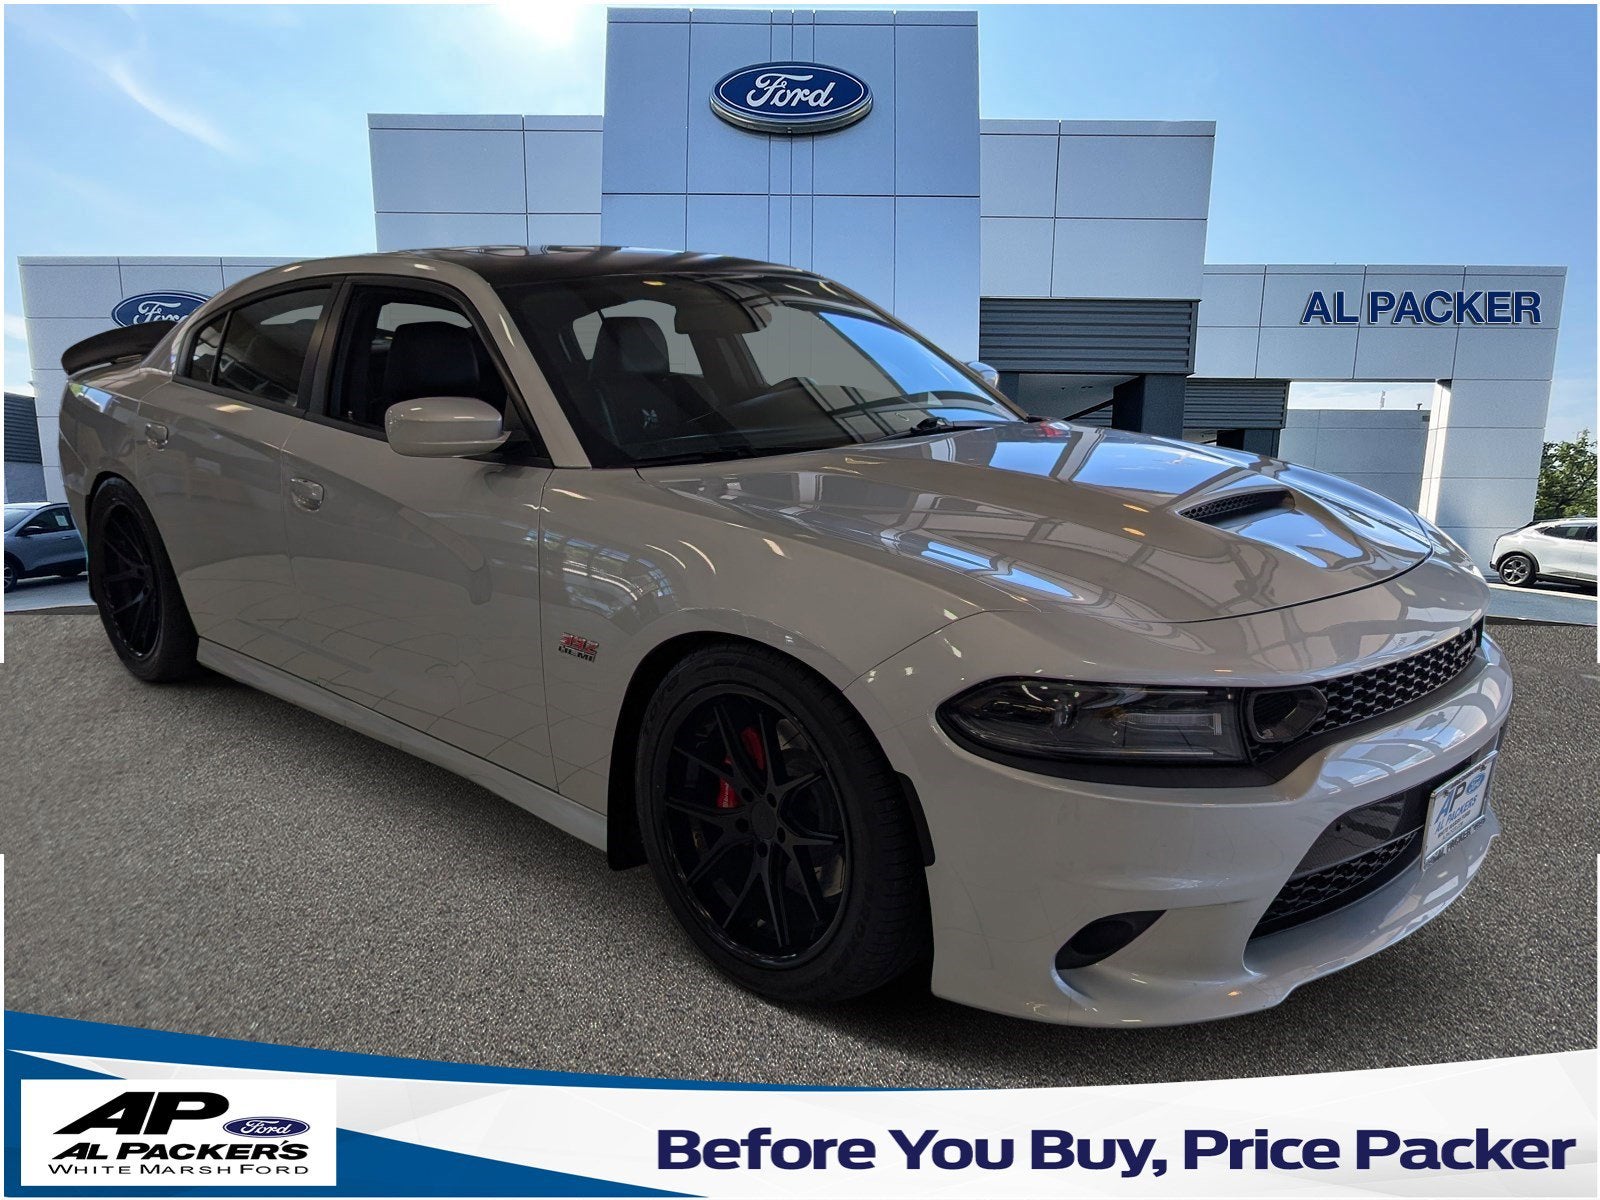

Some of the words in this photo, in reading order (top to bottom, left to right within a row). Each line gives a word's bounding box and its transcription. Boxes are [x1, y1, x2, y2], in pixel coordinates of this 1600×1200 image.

[746, 73, 836, 107] Ford
[1302, 291, 1360, 324] AL
[1368, 290, 1542, 325] PACKER
